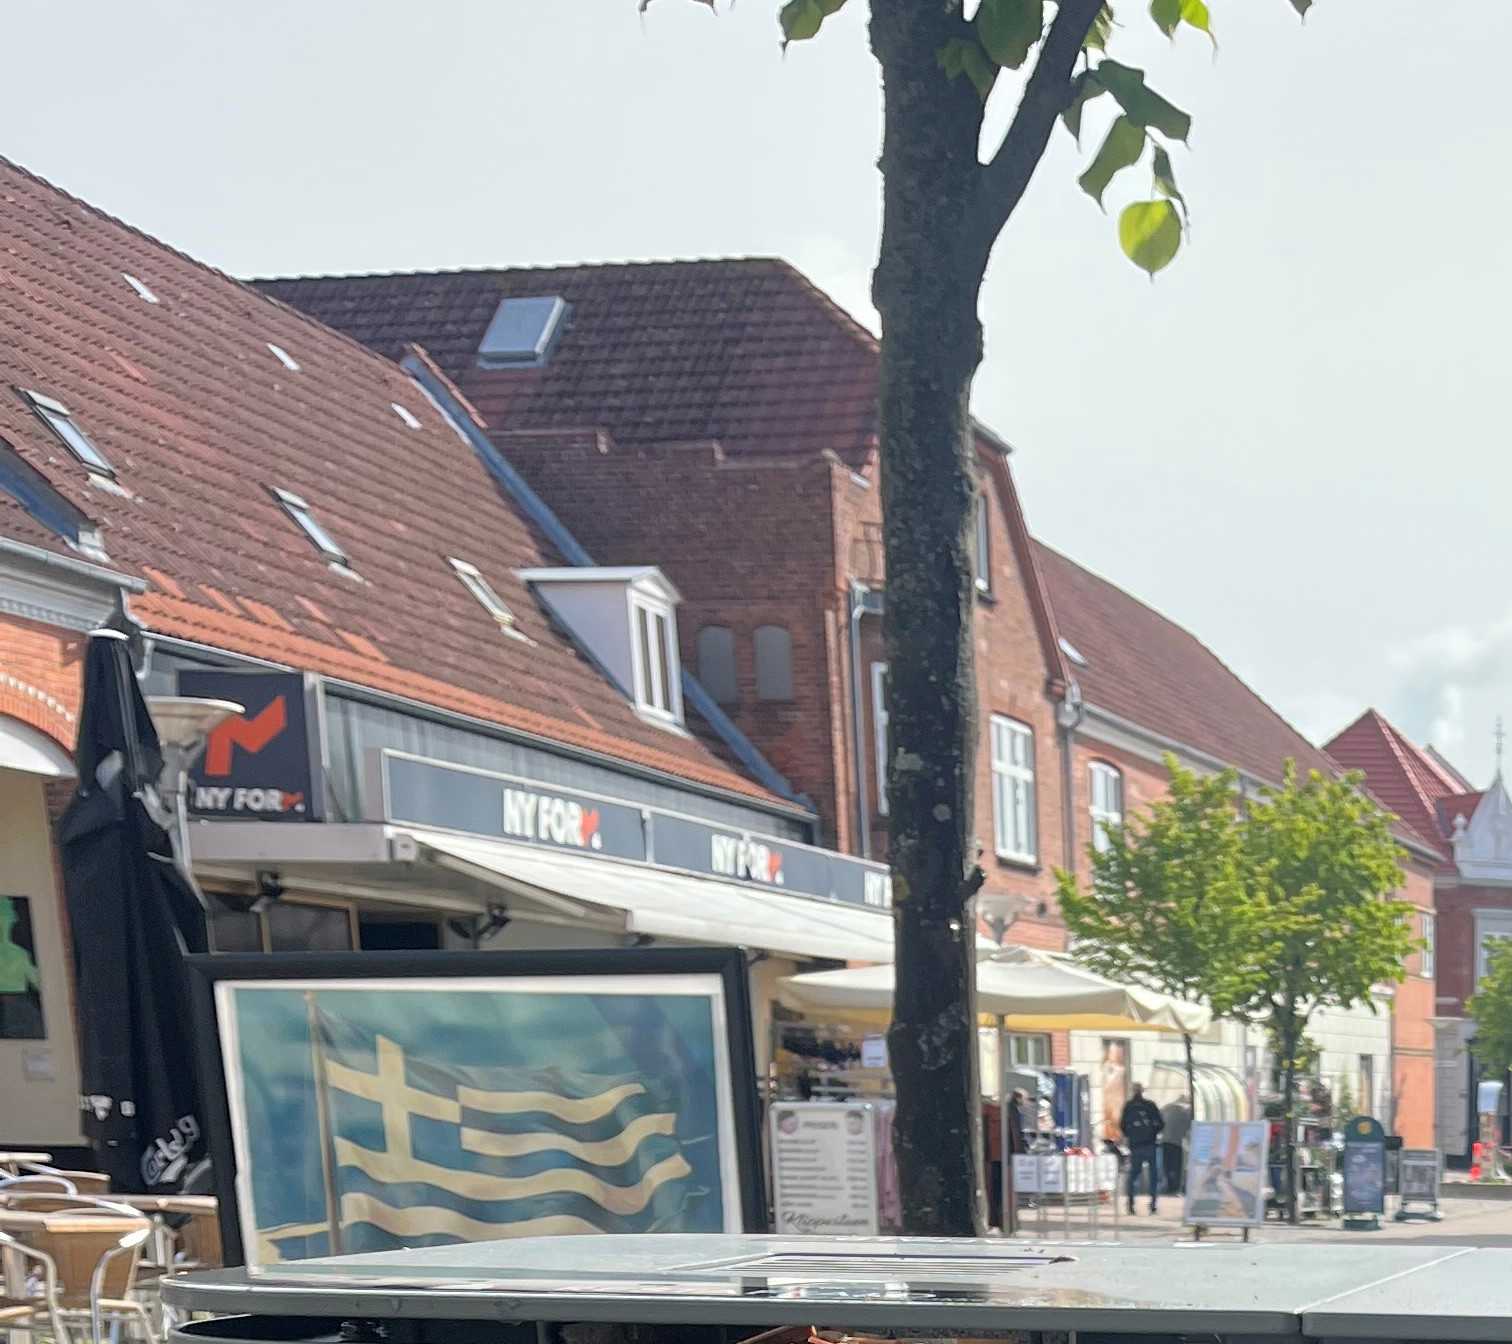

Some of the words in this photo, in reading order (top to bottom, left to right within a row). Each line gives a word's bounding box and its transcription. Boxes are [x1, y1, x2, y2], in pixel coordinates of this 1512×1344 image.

[195, 787, 232, 811] NY
[503, 788, 538, 838] NY
[712, 834, 736, 876] NY
[141, 1113, 201, 1187] Carlsg
